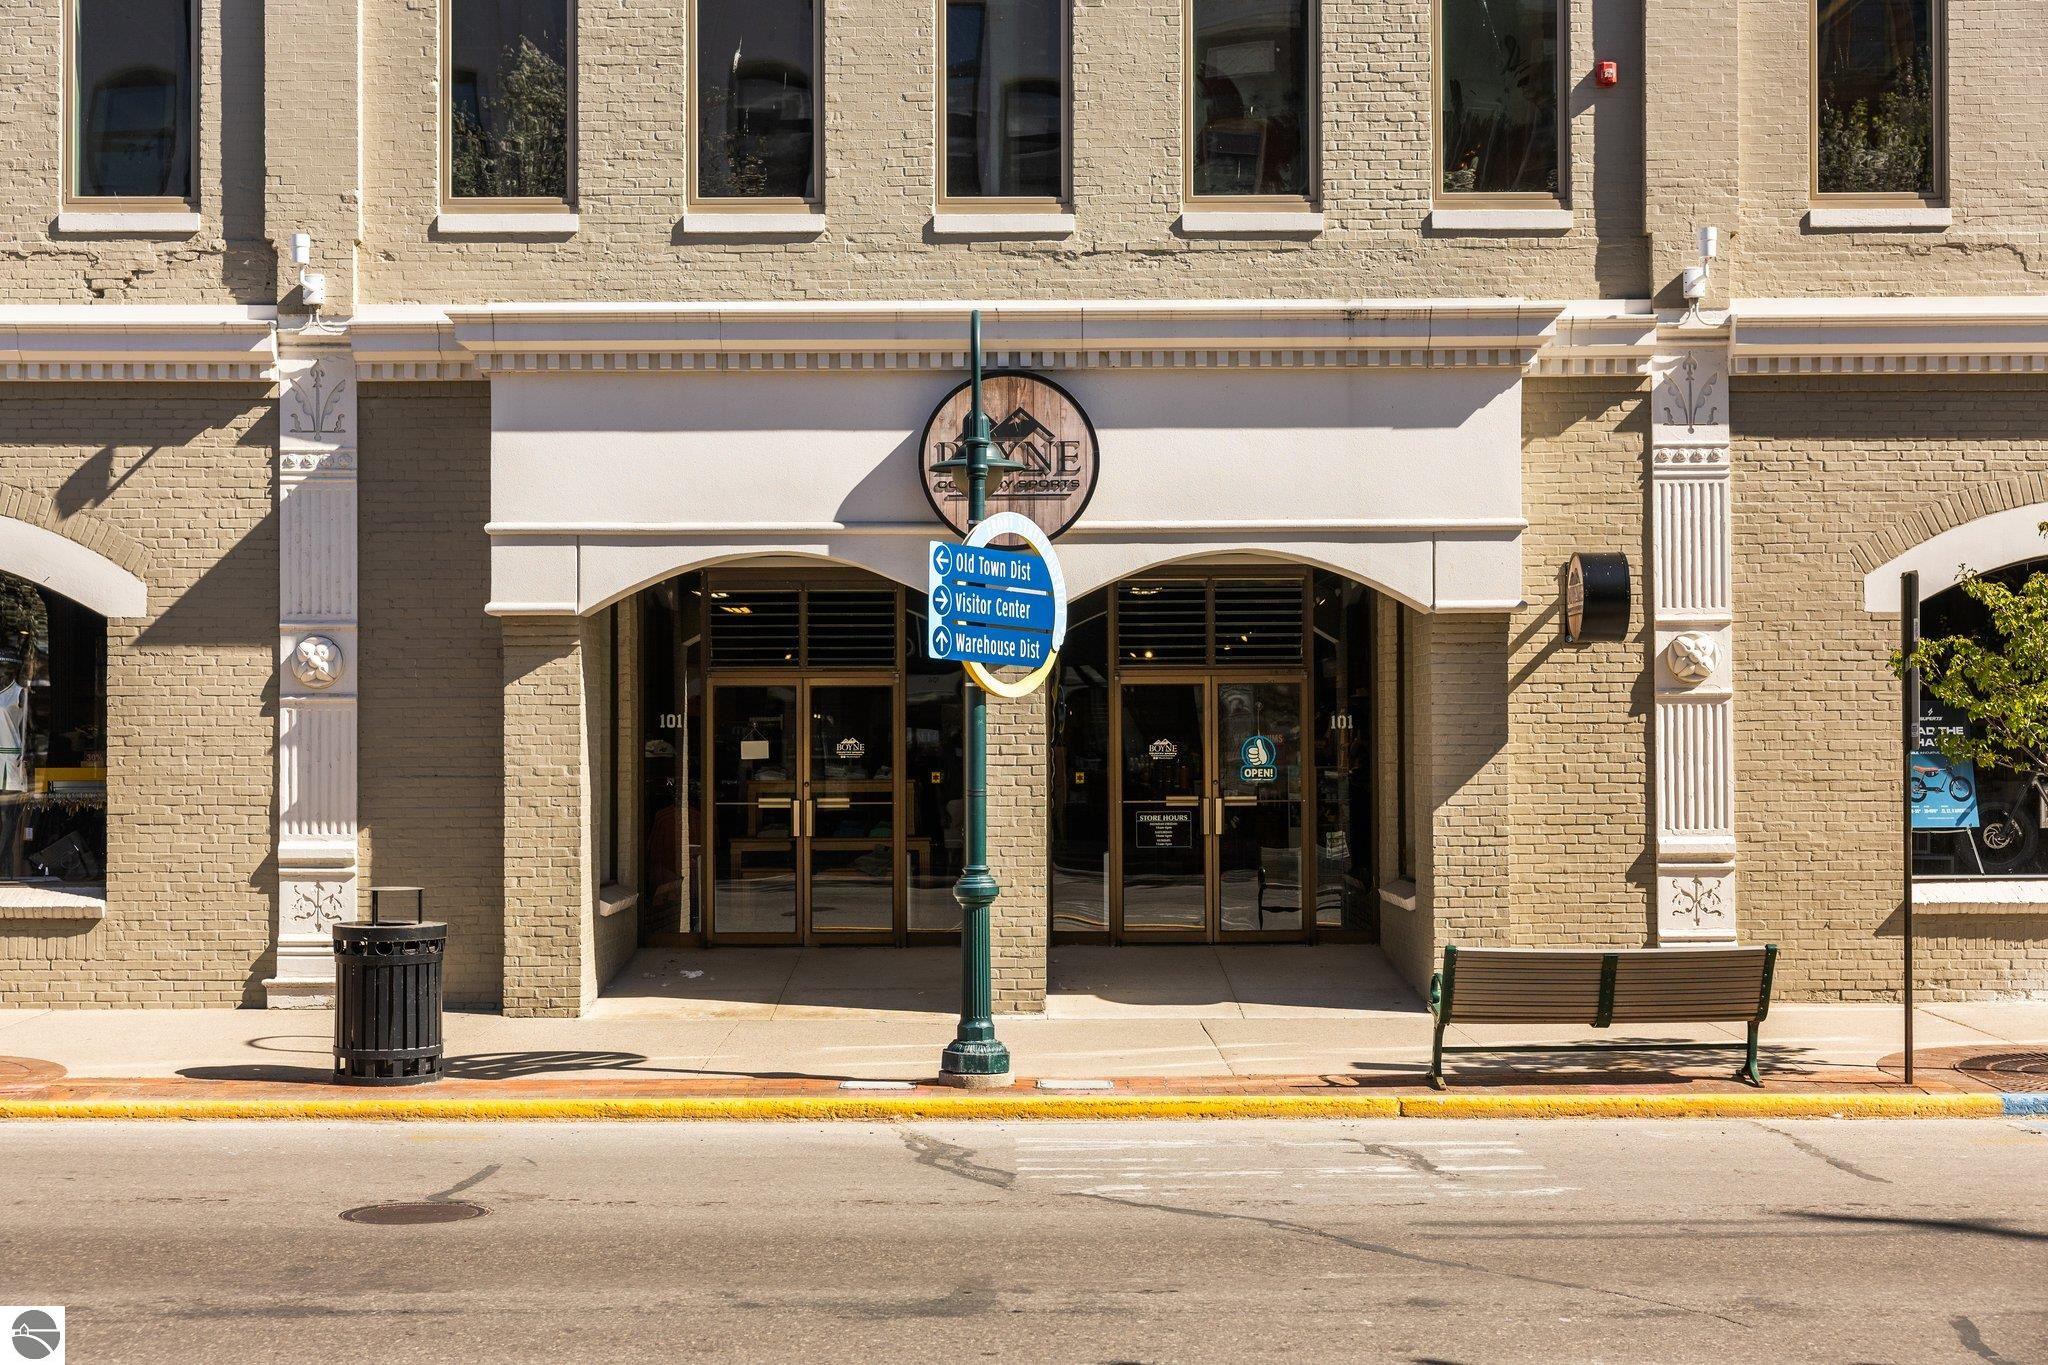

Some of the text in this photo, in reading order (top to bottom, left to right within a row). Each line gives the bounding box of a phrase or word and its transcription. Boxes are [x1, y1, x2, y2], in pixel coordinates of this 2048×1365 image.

[934, 440, 1081, 475] BYNE
[1016, 479, 1080, 491] SPORTS
[955, 553, 1031, 581] Old Town Dist
[955, 592, 1031, 620] Visitor Center
[955, 633, 1040, 660] Warehouse Dist
[659, 713, 683, 728] 101
[1330, 714, 1353, 729] 101
[1919, 726, 1936, 735] AD
[1938, 726, 1964, 735] THE
[836, 743, 865, 751] BOYNE
[1149, 744, 1178, 752] BOYNE
[1244, 768, 1274, 777] OPEN!
[1139, 814, 1161, 822] STORE
